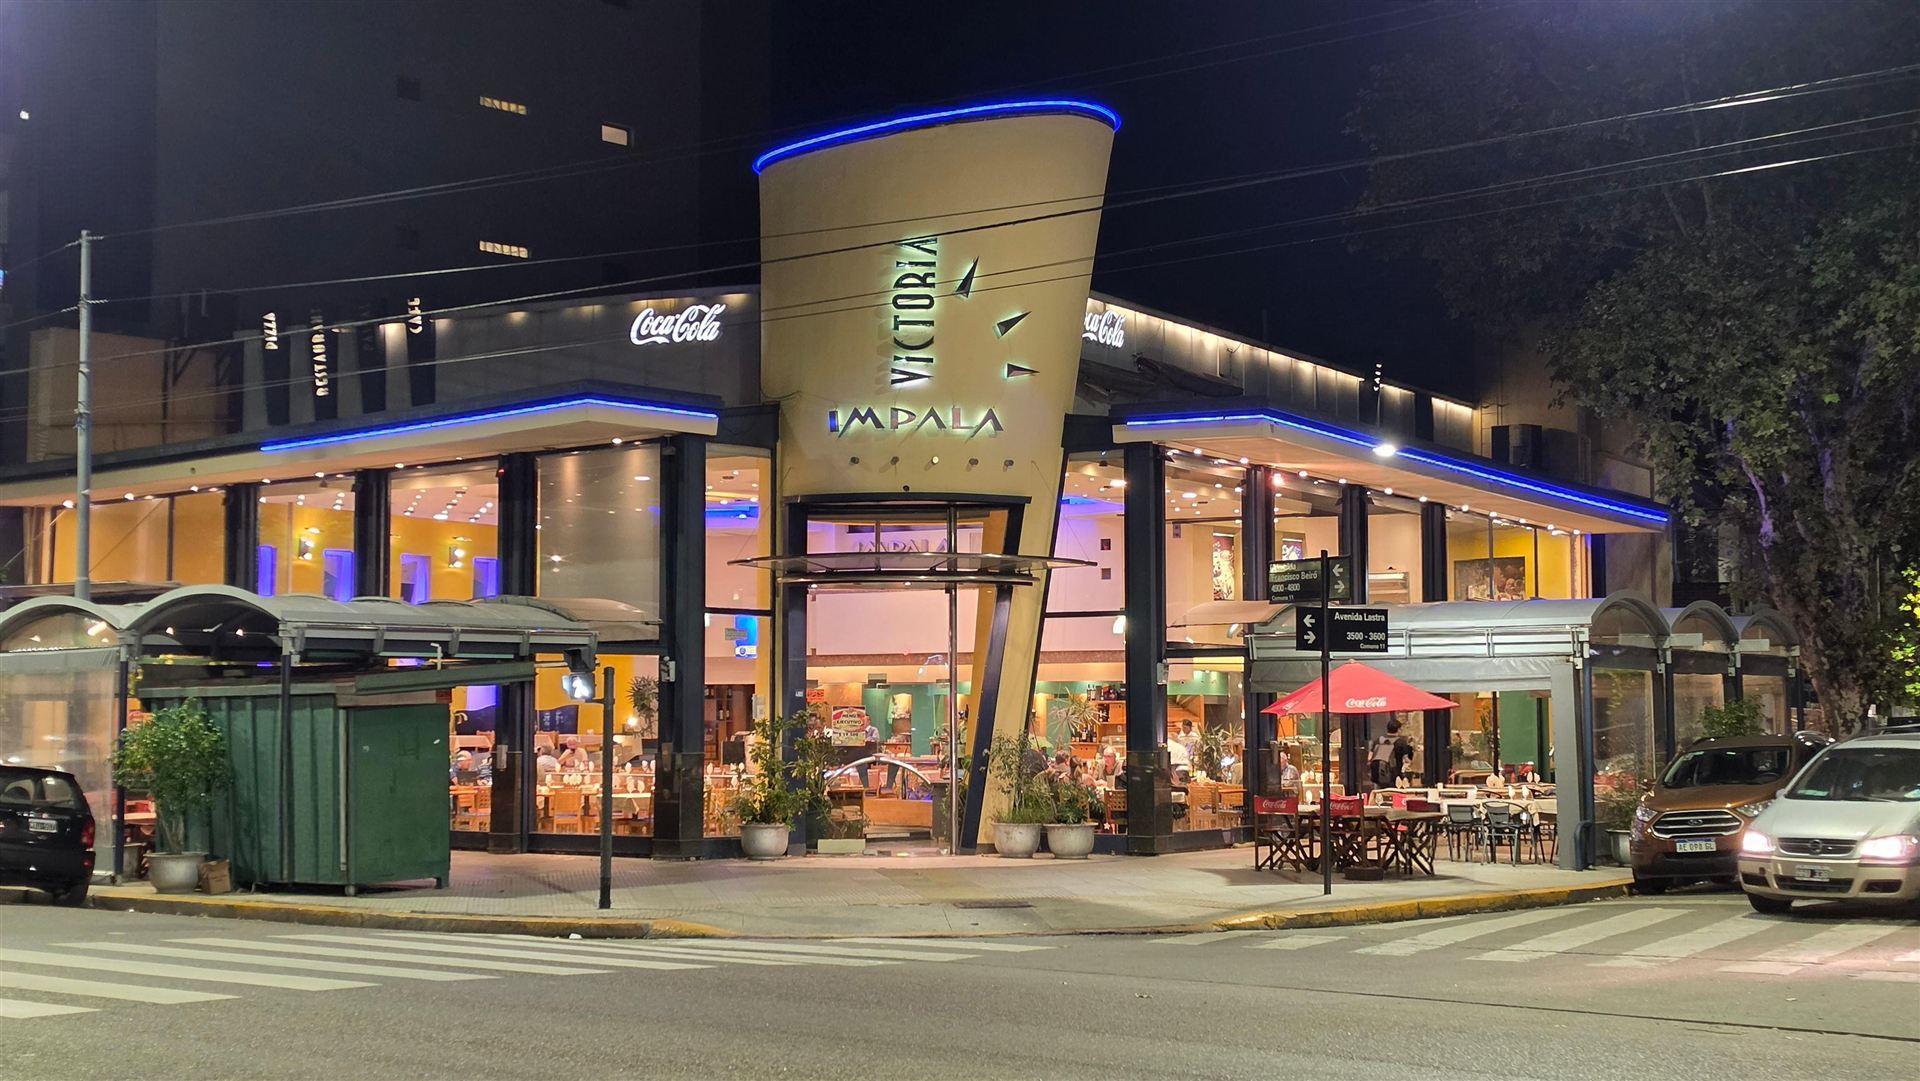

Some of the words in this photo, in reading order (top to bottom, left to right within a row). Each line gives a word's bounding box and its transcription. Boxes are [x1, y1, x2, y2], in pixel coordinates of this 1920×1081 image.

[630, 303, 726, 345] Coca-Cola
[890, 237, 938, 385] VICTORIA
[1082, 310, 1126, 348] ca-Cola
[262, 312, 279, 350] PIZZA
[828, 406, 1004, 441] IMPALA
[1334, 611, 1363, 622] Avenida
[1363, 612, 1386, 622] Lastra
[1346, 631, 1364, 641] 3500
[1368, 631, 1386, 641] 3600
[1345, 697, 1387, 708] Coca-Cola
